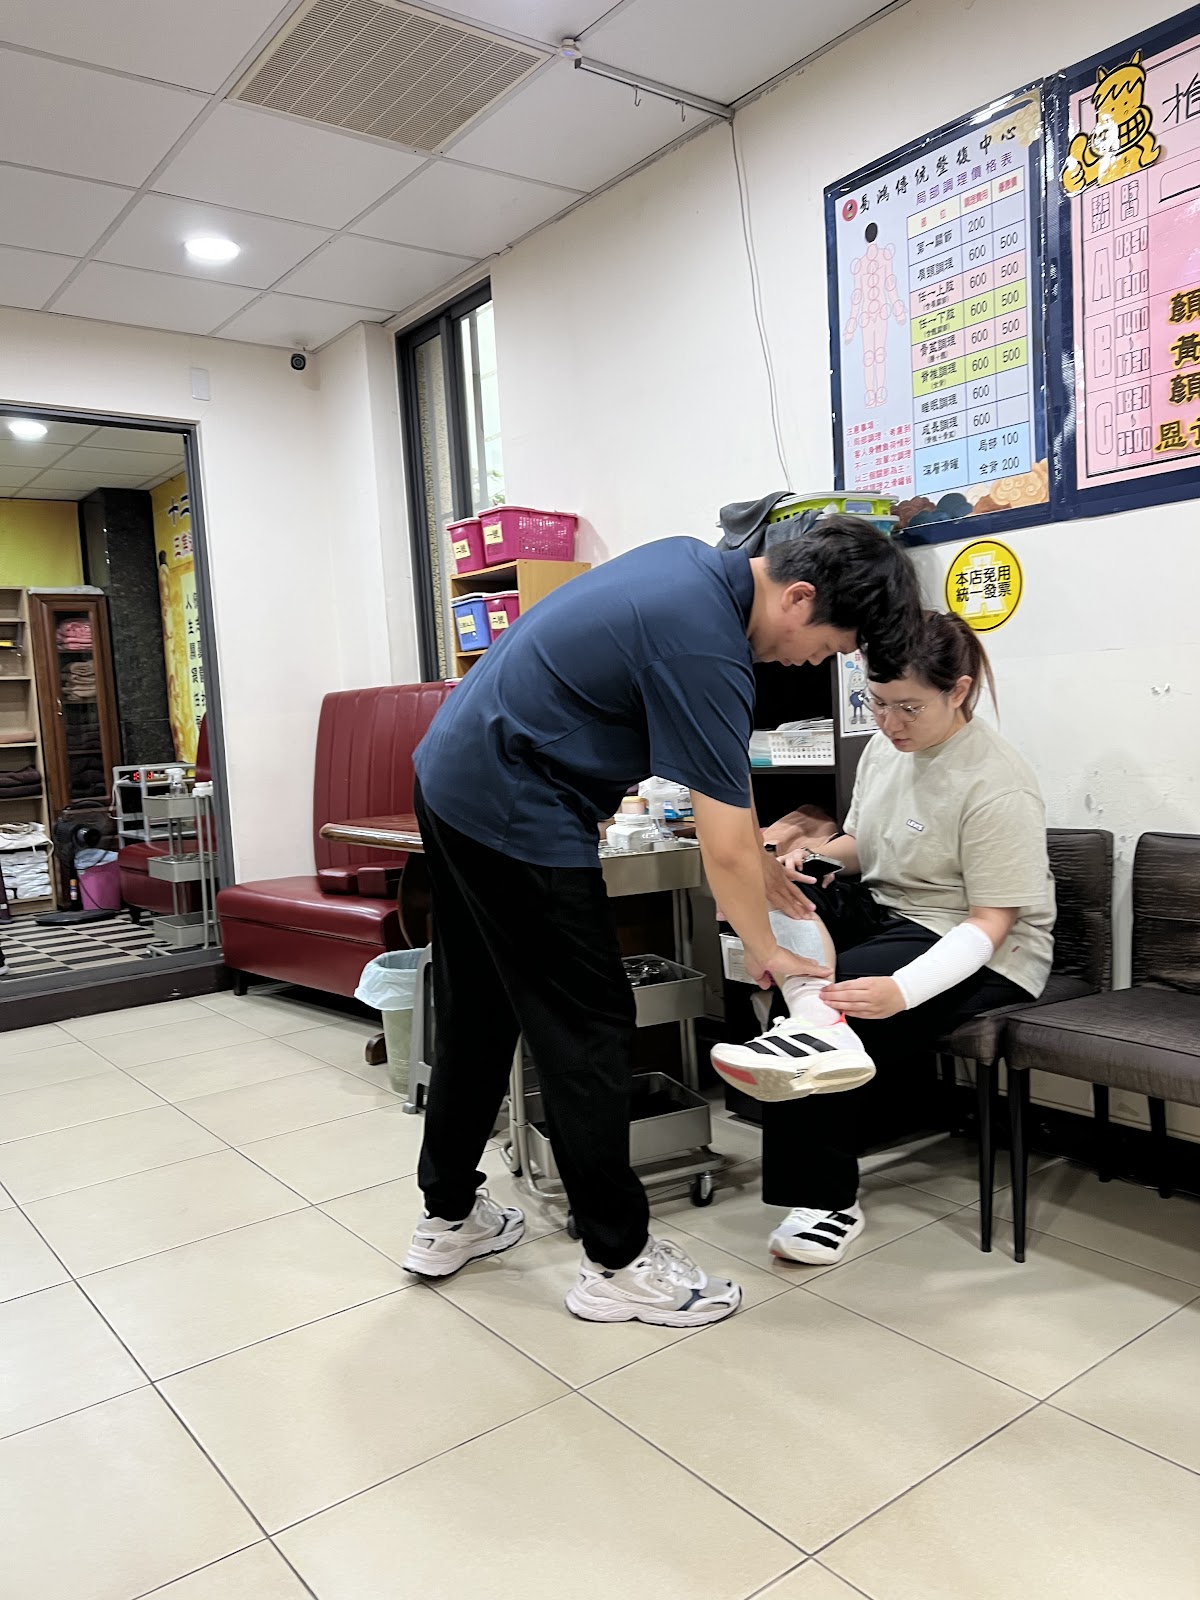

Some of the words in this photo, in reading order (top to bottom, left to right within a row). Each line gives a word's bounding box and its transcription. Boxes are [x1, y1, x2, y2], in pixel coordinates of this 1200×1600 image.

[916, 152, 1014, 206] 局部調理價格表
[1121, 179, 1140, 221] 時間
[968, 216, 986, 233] 200
[916, 229, 953, 255] 第一關節
[1000, 232, 1019, 249] 500
[1115, 225, 1150, 260] 0830
[969, 244, 987, 261] 600
[1001, 261, 1019, 278] 500
[1092, 247, 1112, 302] A
[969, 272, 987, 289] 600
[1115, 269, 1150, 302] 1200
[970, 300, 988, 316] 600
[1001, 290, 1020, 307] 500
[1002, 318, 1020, 335] 500
[1116, 306, 1150, 339] 1400
[971, 328, 989, 344] 600
[1002, 346, 1021, 363] 500
[1093, 324, 1112, 378] B
[972, 356, 990, 372] 600
[1116, 347, 1151, 379] 1730
[973, 384, 990, 400] 600
[1116, 384, 1151, 415] 1830
[921, 393, 958, 413] 睡眠調理
[922, 416, 958, 436] 成長調理
[973, 412, 991, 427] 600
[1095, 401, 1113, 456] C
[978, 437, 998, 452] 局部
[1002, 431, 1019, 446] 100
[1117, 426, 1152, 457] 2200
[979, 460, 999, 476] 全背
[1002, 456, 1020, 471] 200
[956, 565, 1011, 586] 本店免用
[956, 580, 1012, 602] 統一發票
